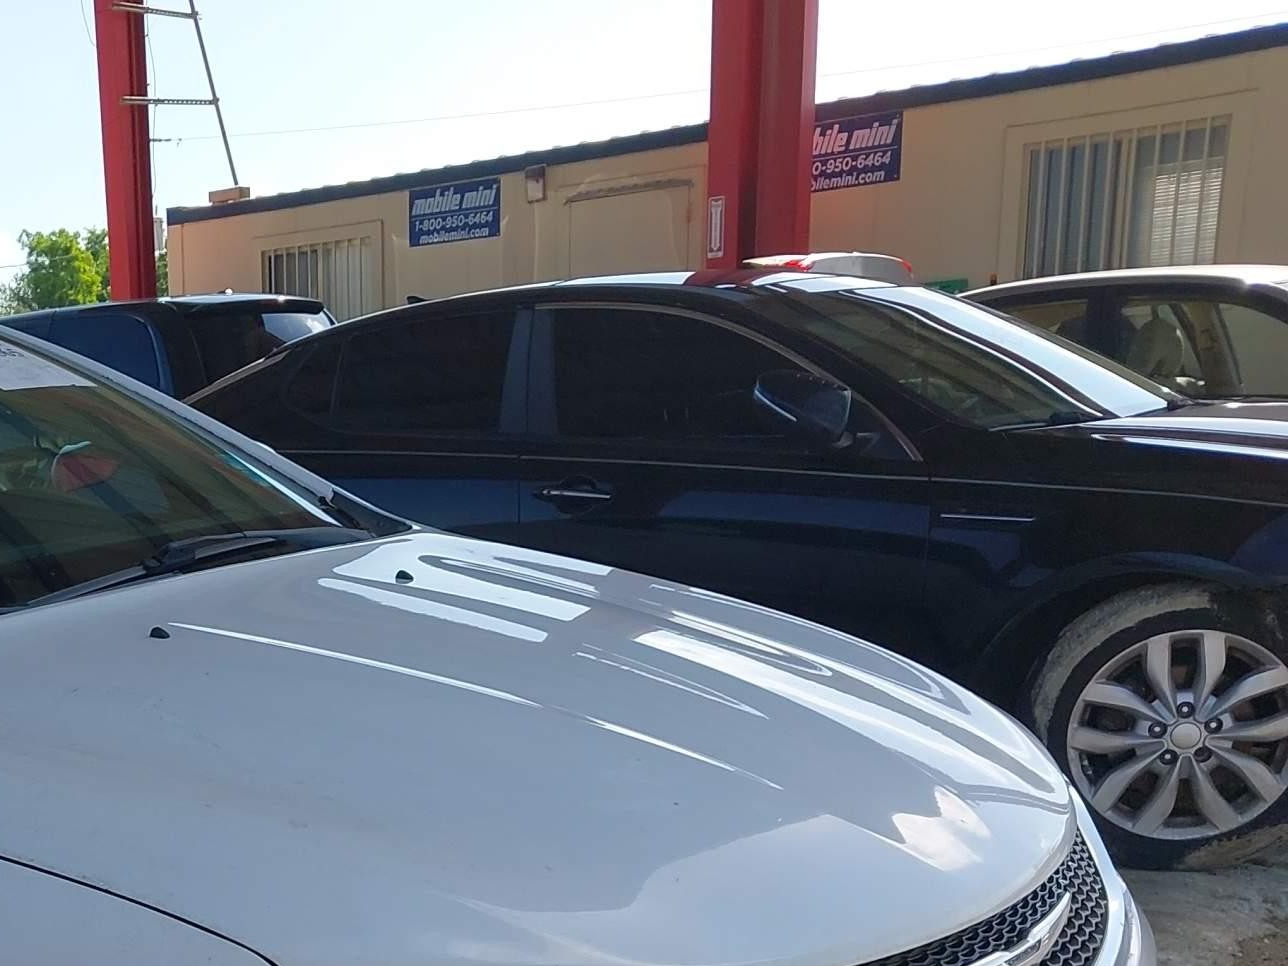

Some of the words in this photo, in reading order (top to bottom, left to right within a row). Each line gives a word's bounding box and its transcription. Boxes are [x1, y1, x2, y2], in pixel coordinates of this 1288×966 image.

[849, 119, 898, 149] mini
[412, 187, 461, 215] mobile
[462, 185, 497, 209] mini
[415, 211, 493, 231] 1-800-950-6464
[419, 227, 489, 244] mobilemini.com
